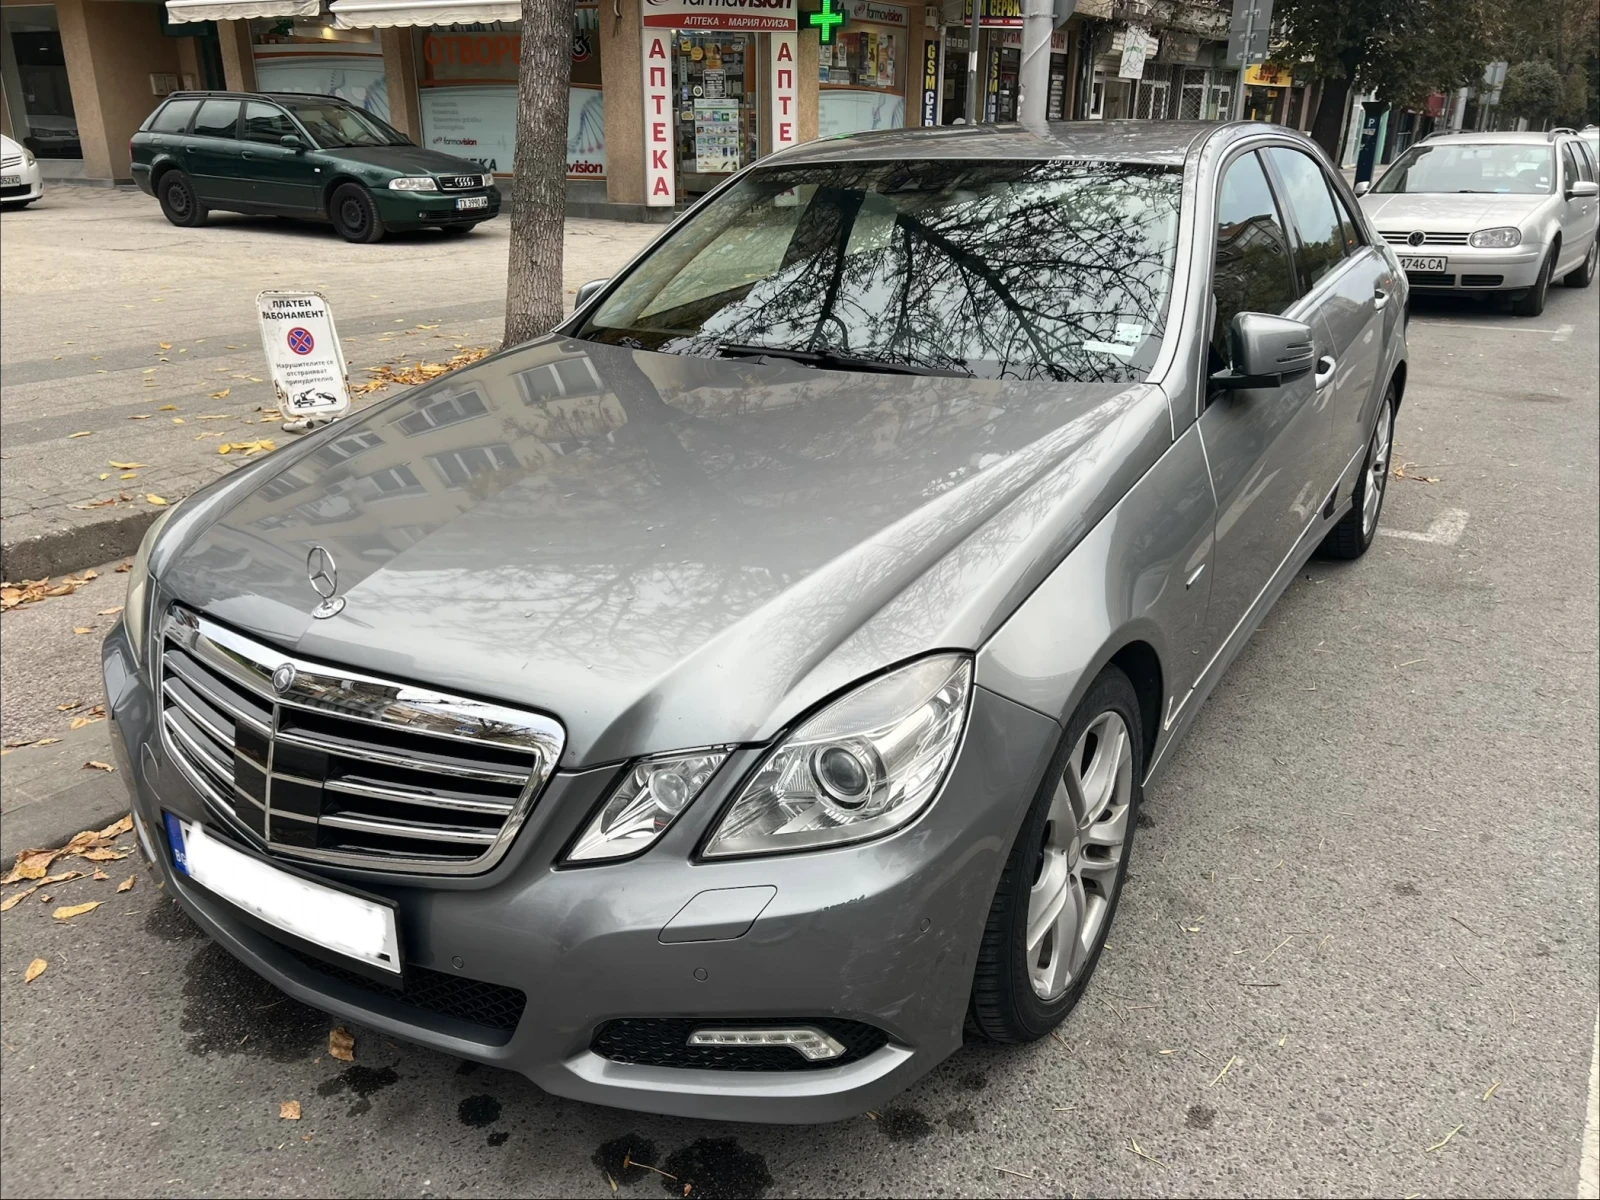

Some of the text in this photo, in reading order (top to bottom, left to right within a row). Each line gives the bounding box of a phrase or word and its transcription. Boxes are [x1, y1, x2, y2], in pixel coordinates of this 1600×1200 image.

[966, 0, 986, 15] GM
[684, 17, 789, 27] АПТЕКА МАРИЯ ЛУИЗА
[926, 45, 935, 90] GSM
[649, 39, 669, 195] АПТЕКА
[1369, 118, 1375, 127] P
[567, 160, 603, 173] vision
[1428, 259, 1443, 269] CA
[272, 299, 312, 308] ПЛАТЕН
[265, 310, 324, 320] АБОНАМЕНТ
[276, 360, 325, 370] Нарушителите
[286, 368, 328, 377] отстраняват
[285, 376, 334, 386] принудително
